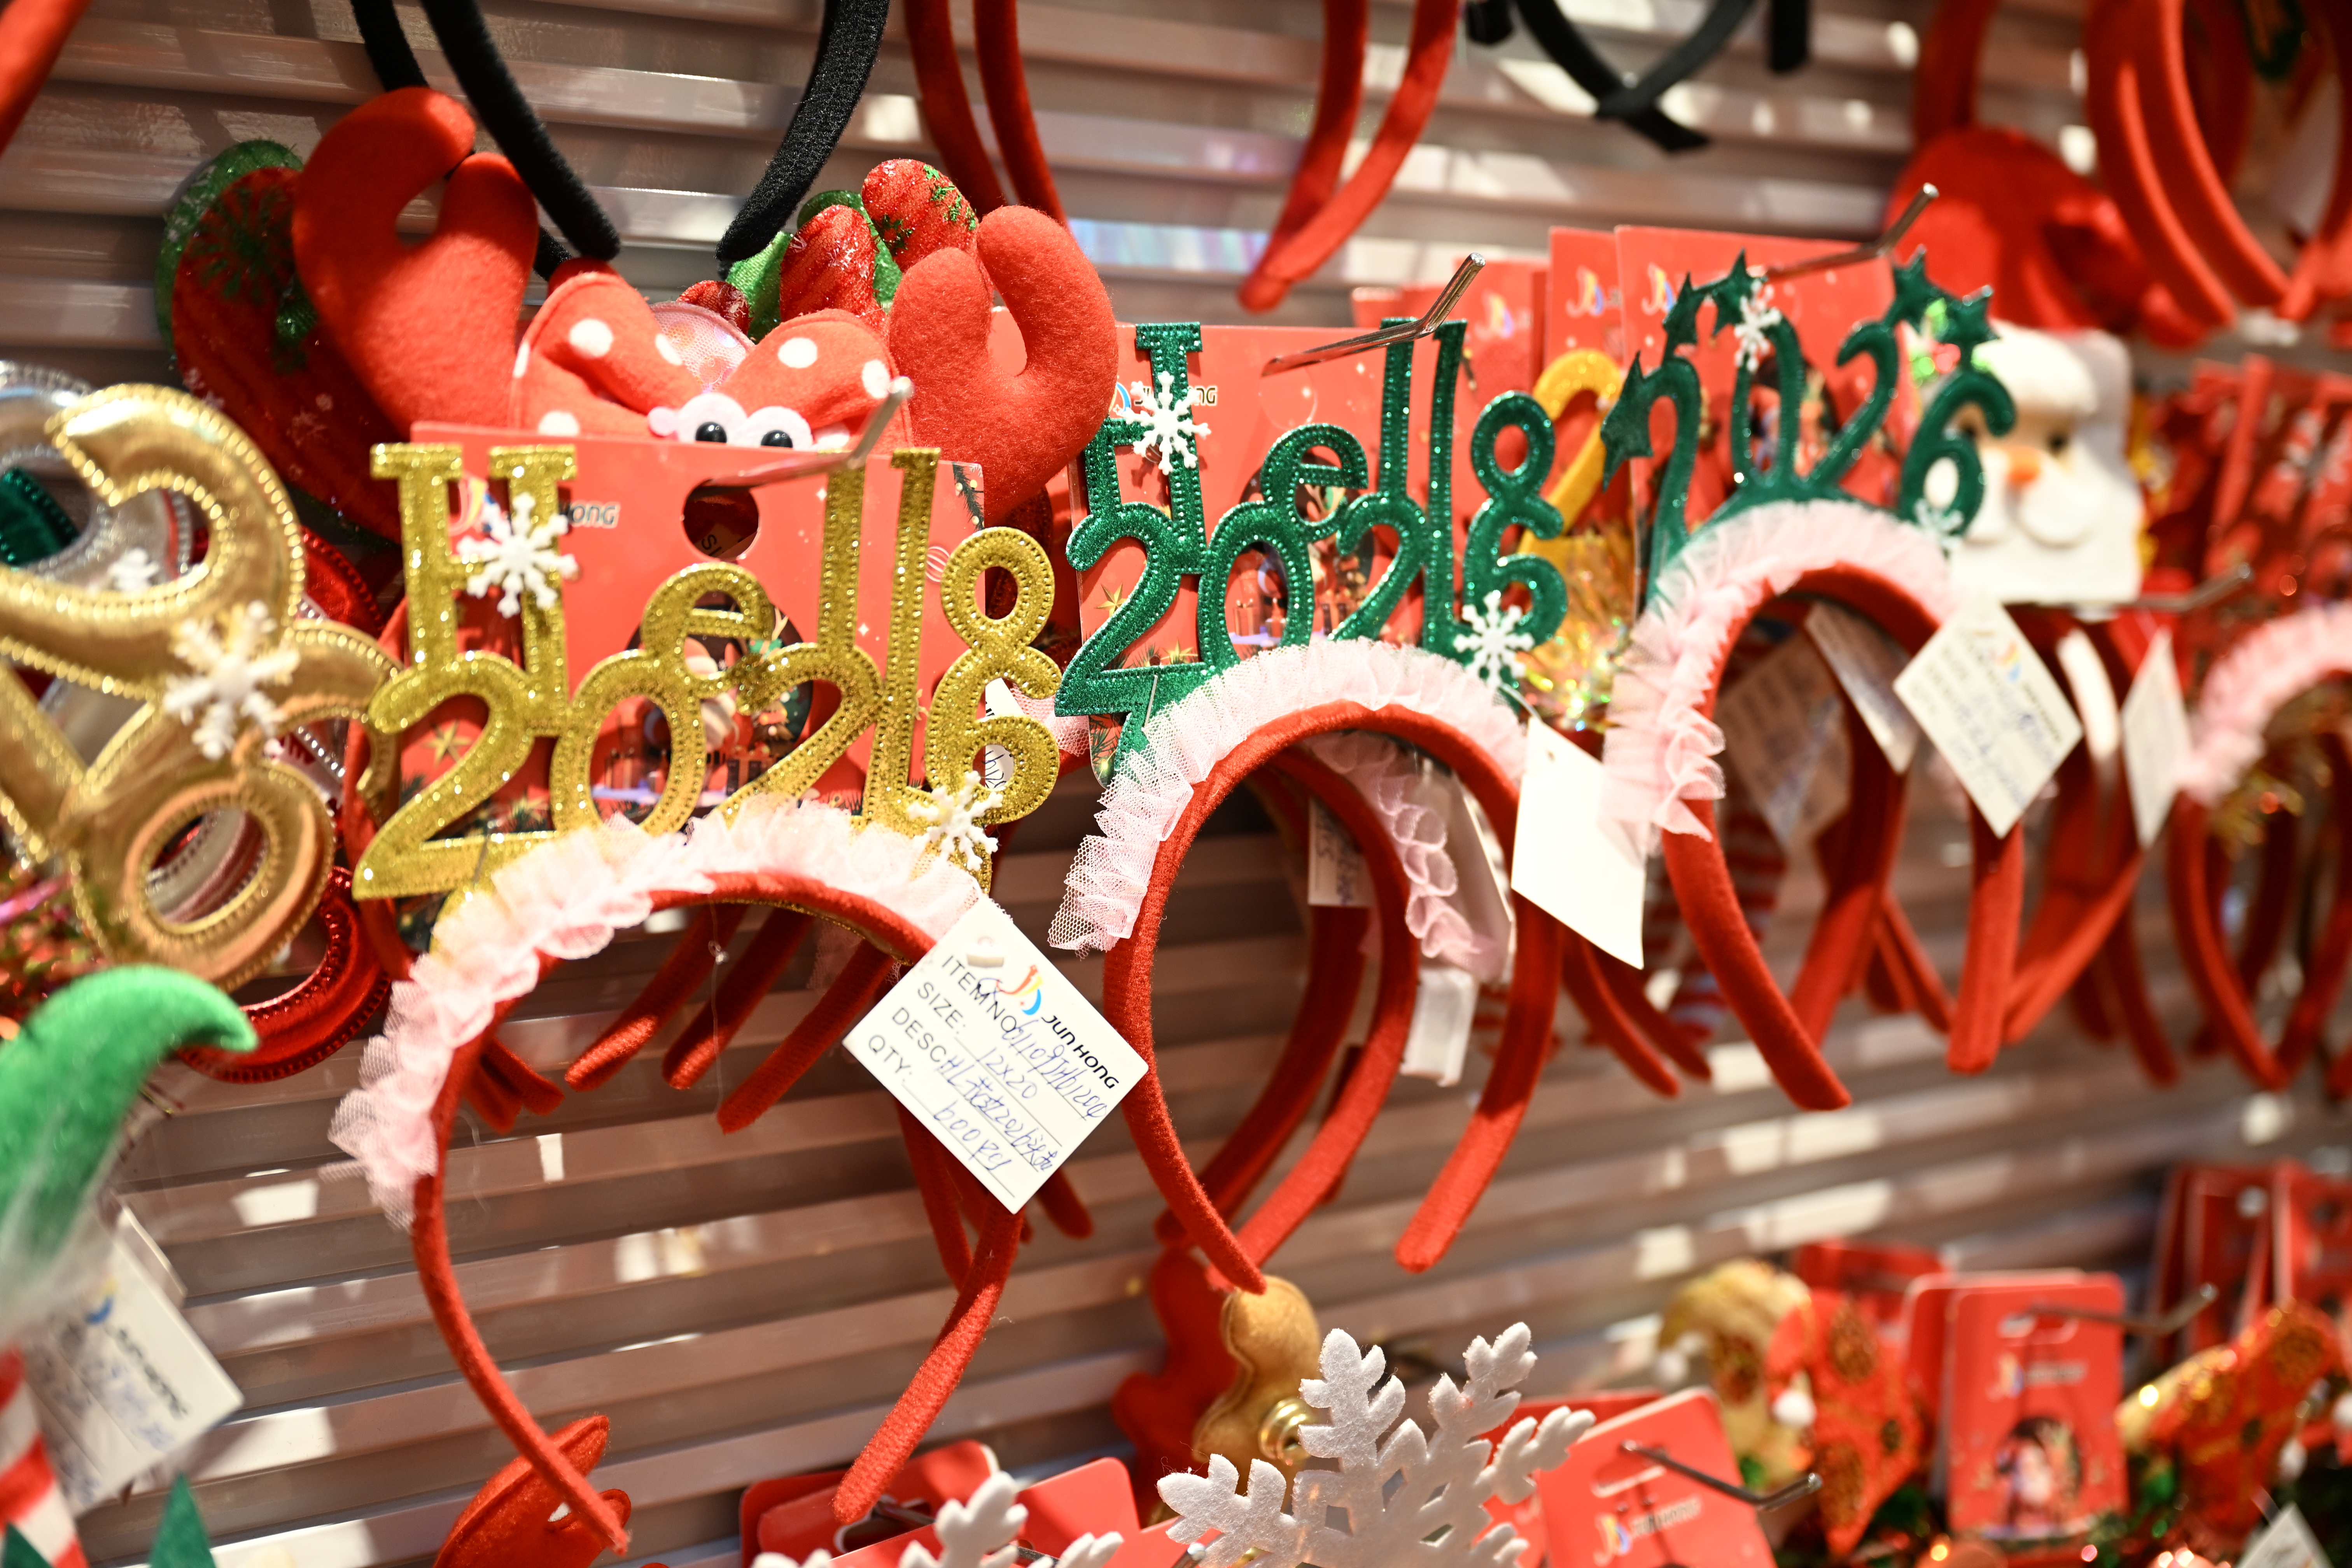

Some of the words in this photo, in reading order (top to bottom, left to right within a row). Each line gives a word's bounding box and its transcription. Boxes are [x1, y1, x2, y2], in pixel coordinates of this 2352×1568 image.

[1083, 318, 1556, 646] Hello
[371, 443, 1055, 819] Hello
[1055, 492, 1568, 717] 2026
[352, 642, 1061, 899] 2026
[917, 982, 967, 1034] SIZE:
[942, 955, 991, 1005] ITEM
[1041, 1015, 1076, 1046] JUN
[1072, 1044, 1120, 1089] HONG
[868, 1035, 913, 1083] QTY:
